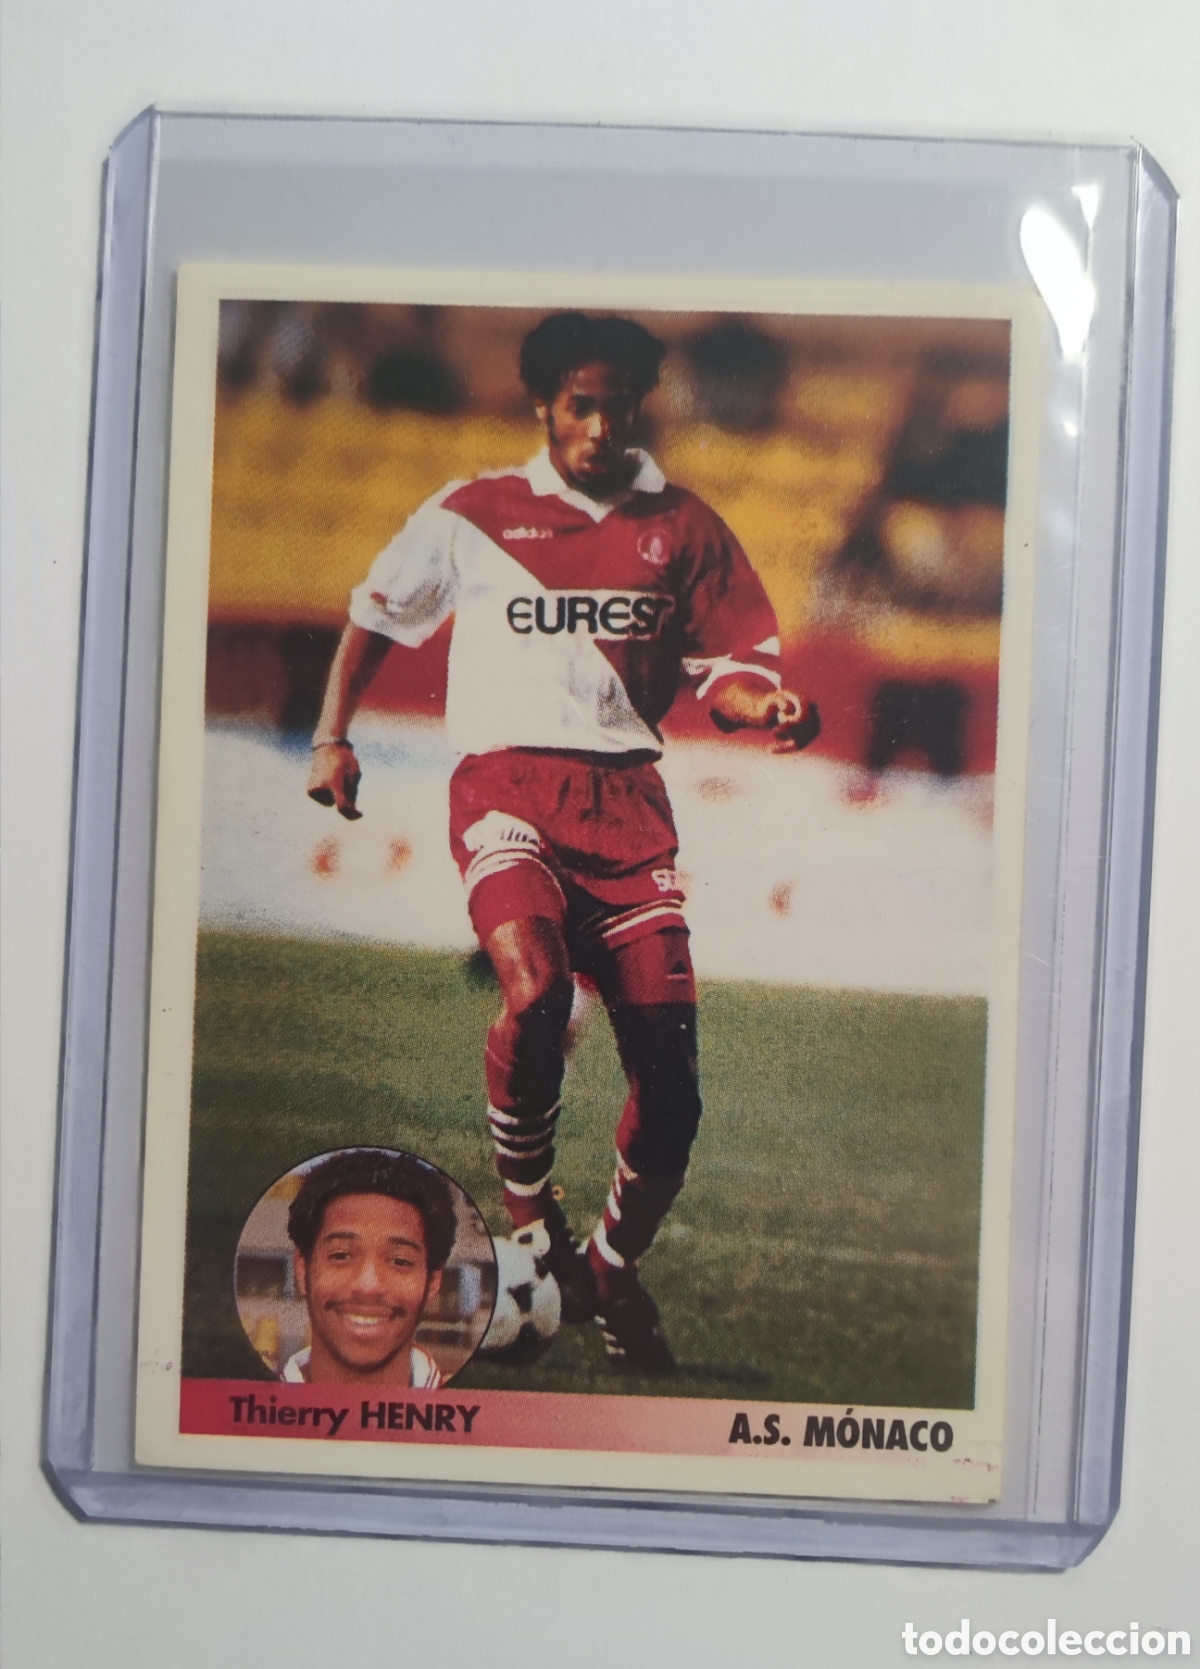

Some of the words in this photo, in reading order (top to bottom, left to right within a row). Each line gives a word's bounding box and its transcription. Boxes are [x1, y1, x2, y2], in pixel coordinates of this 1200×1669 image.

[507, 597, 675, 634] EUREST
[229, 1394, 349, 1436] Thierry
[360, 1401, 481, 1432] HENRY
[728, 1412, 791, 1446] A.S.
[803, 1408, 954, 1452] MÓNACO
